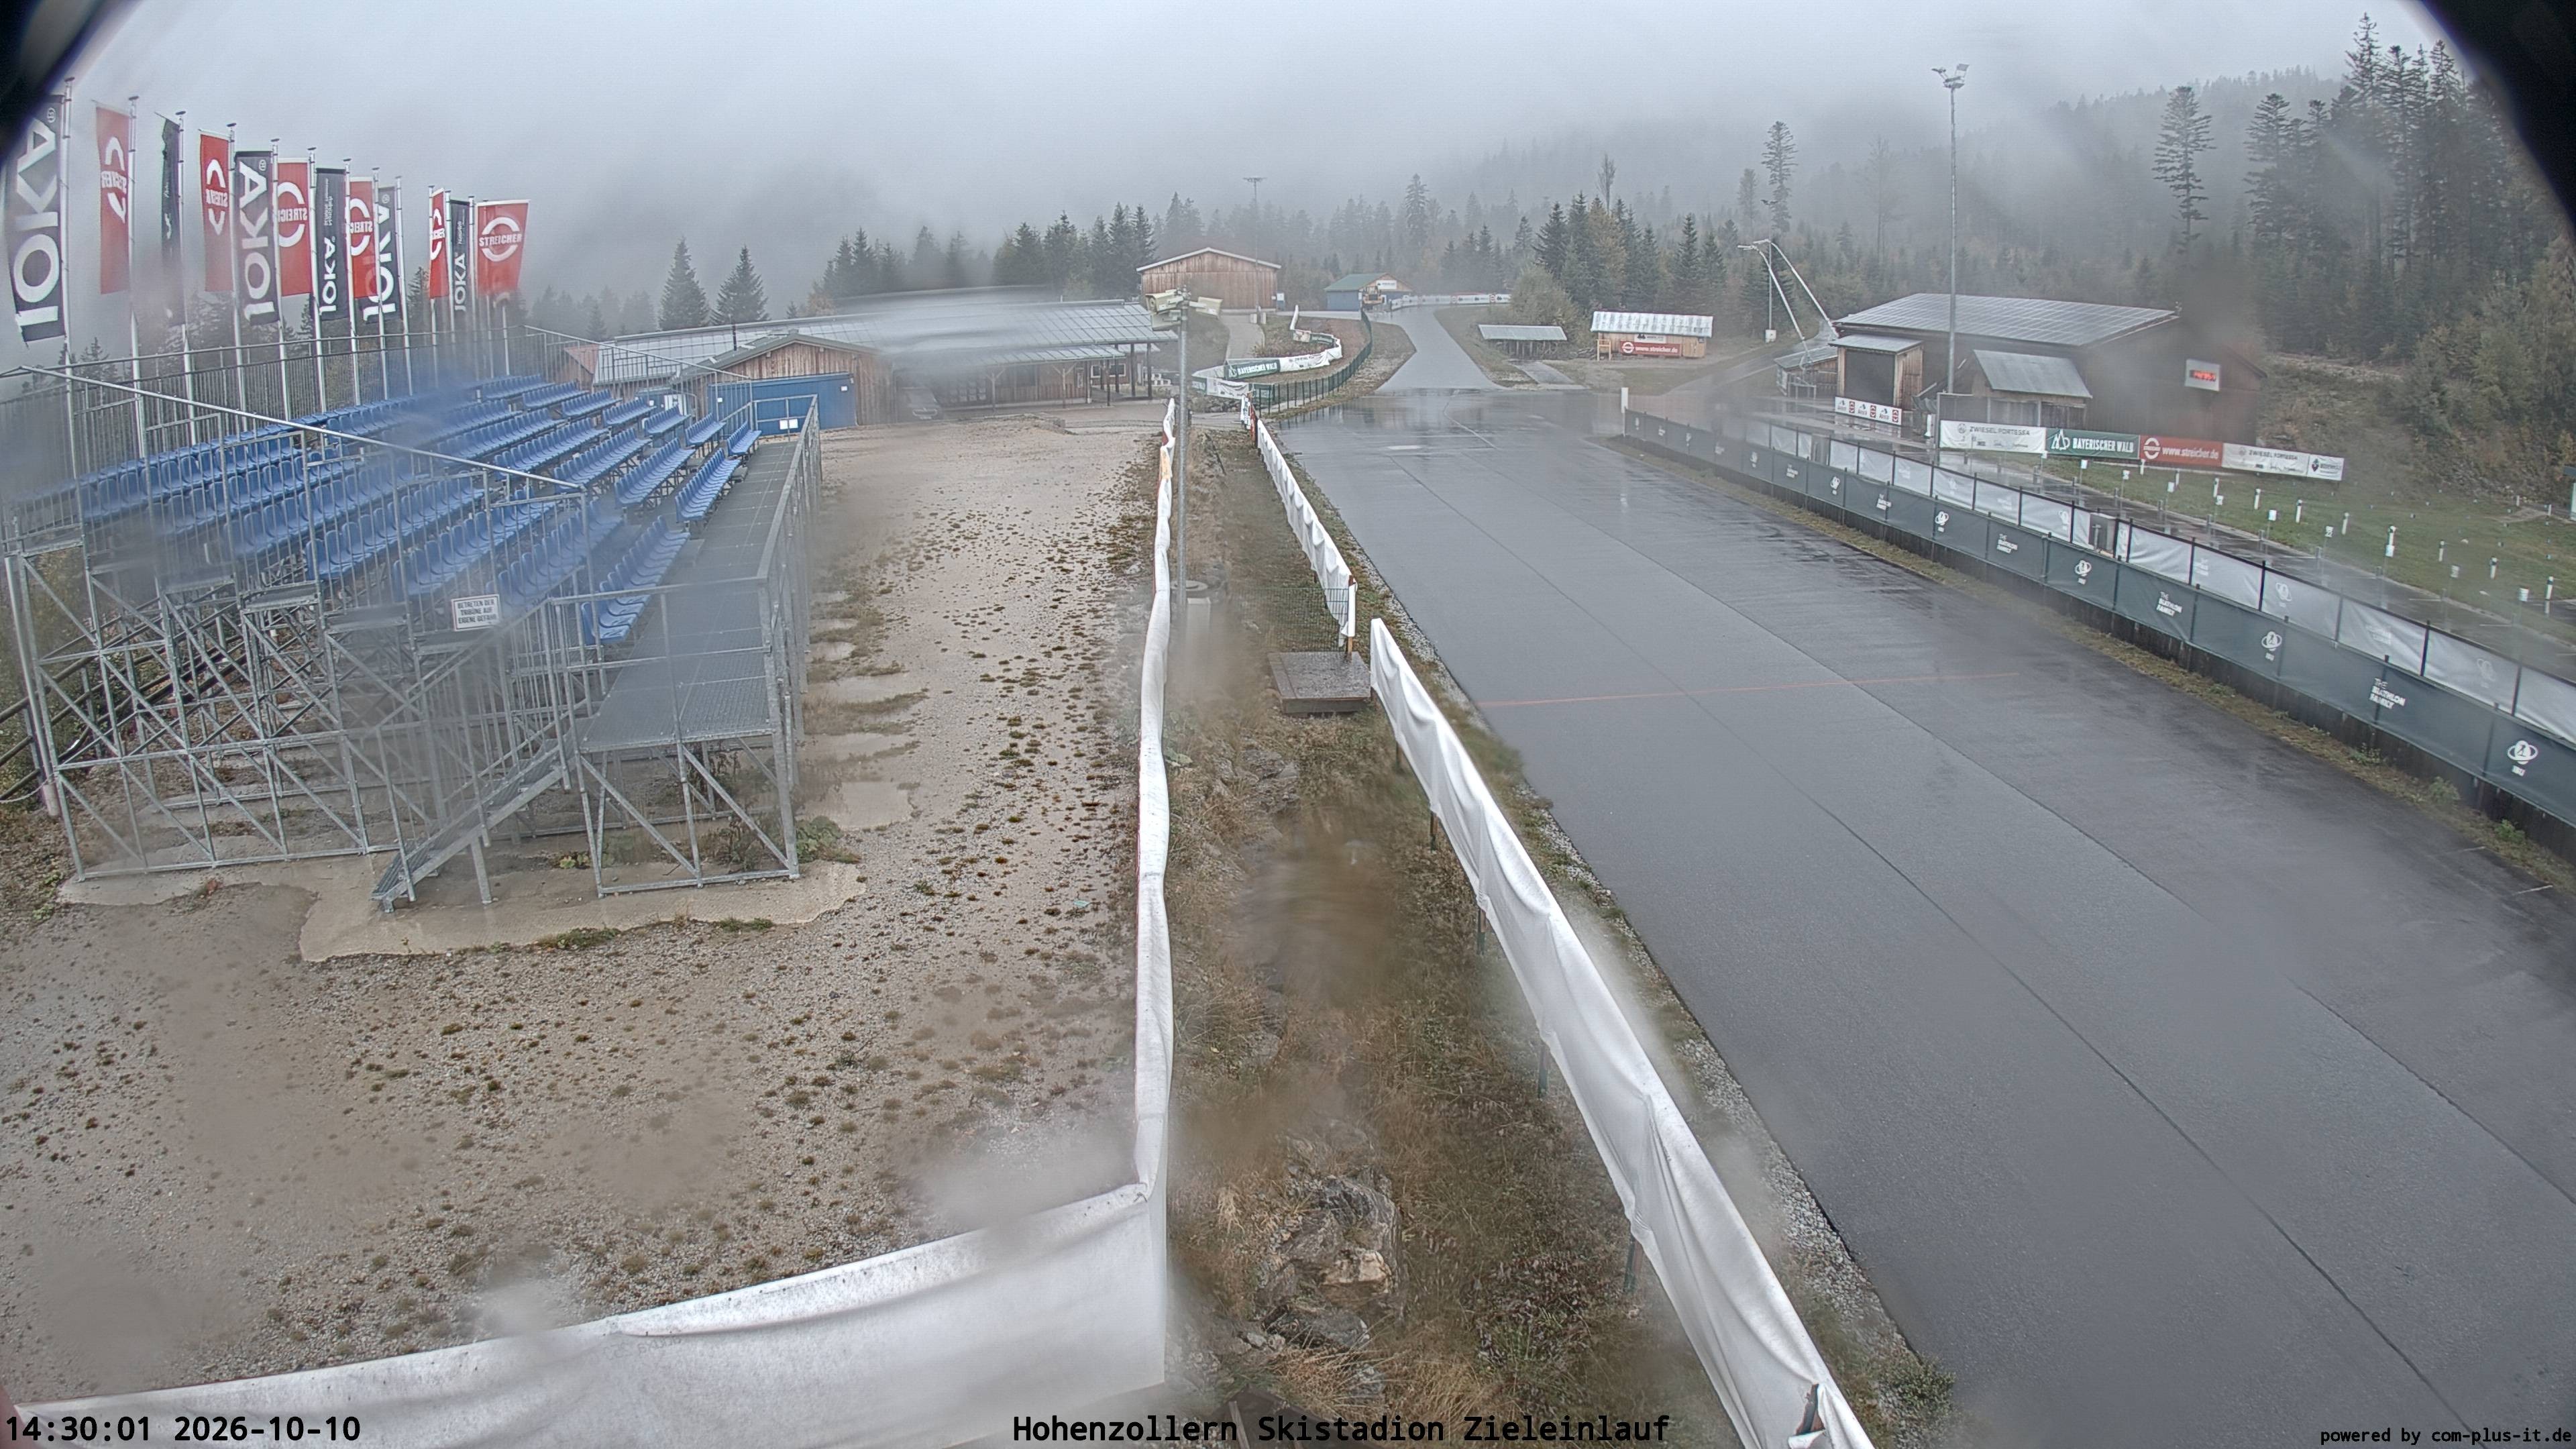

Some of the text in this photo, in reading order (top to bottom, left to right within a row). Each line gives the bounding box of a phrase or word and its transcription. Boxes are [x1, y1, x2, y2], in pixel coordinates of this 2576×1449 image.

[479, 233, 523, 248] STREICHER
[454, 252, 466, 312] JOKA
[2073, 437, 2134, 453] BAYERISCHER WALD
[2162, 447, 2219, 460] www.streicher.de
